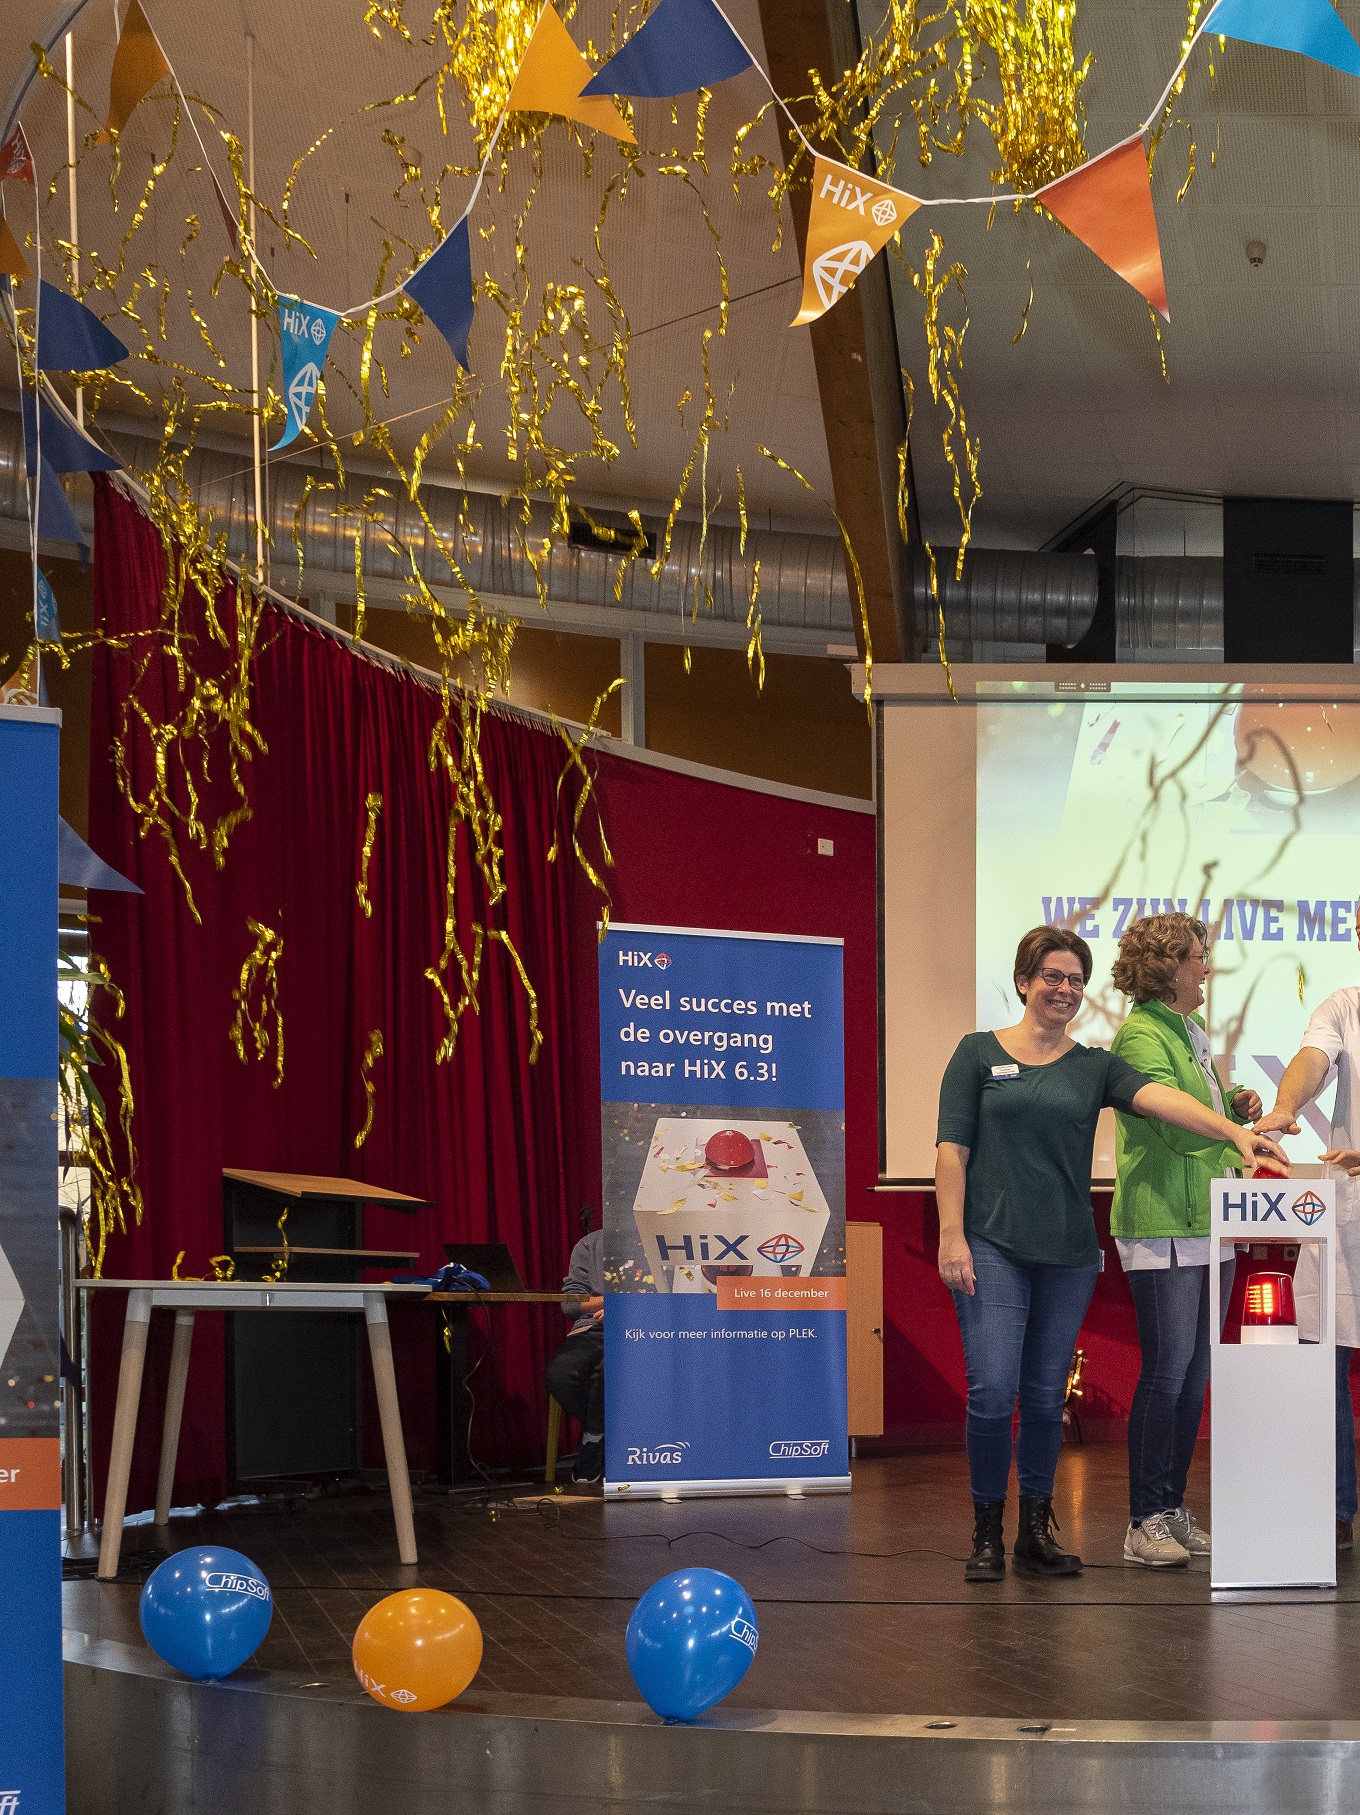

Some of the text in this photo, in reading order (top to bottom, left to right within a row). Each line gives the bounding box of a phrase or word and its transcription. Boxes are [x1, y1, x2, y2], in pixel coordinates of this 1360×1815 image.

[820, 174, 874, 217] HiX
[283, 308, 311, 339] HiX
[1296, 899, 1358, 942] ME
[618, 950, 653, 968] HiX
[618, 988, 812, 1019] Veel succes met
[619, 1021, 774, 1054] de overgang
[620, 1058, 778, 1082] naar HiX 6.3!
[1222, 1191, 1288, 1223] HiX
[655, 1234, 751, 1261] HiX
[734, 1288, 829, 1298] Live 16 december
[625, 1328, 818, 1341] Kijk voor meer informatie op PLEK.
[626, 1439, 830, 1465] Rivas ChipSoft
[205, 1572, 270, 1602] ChipSoft
